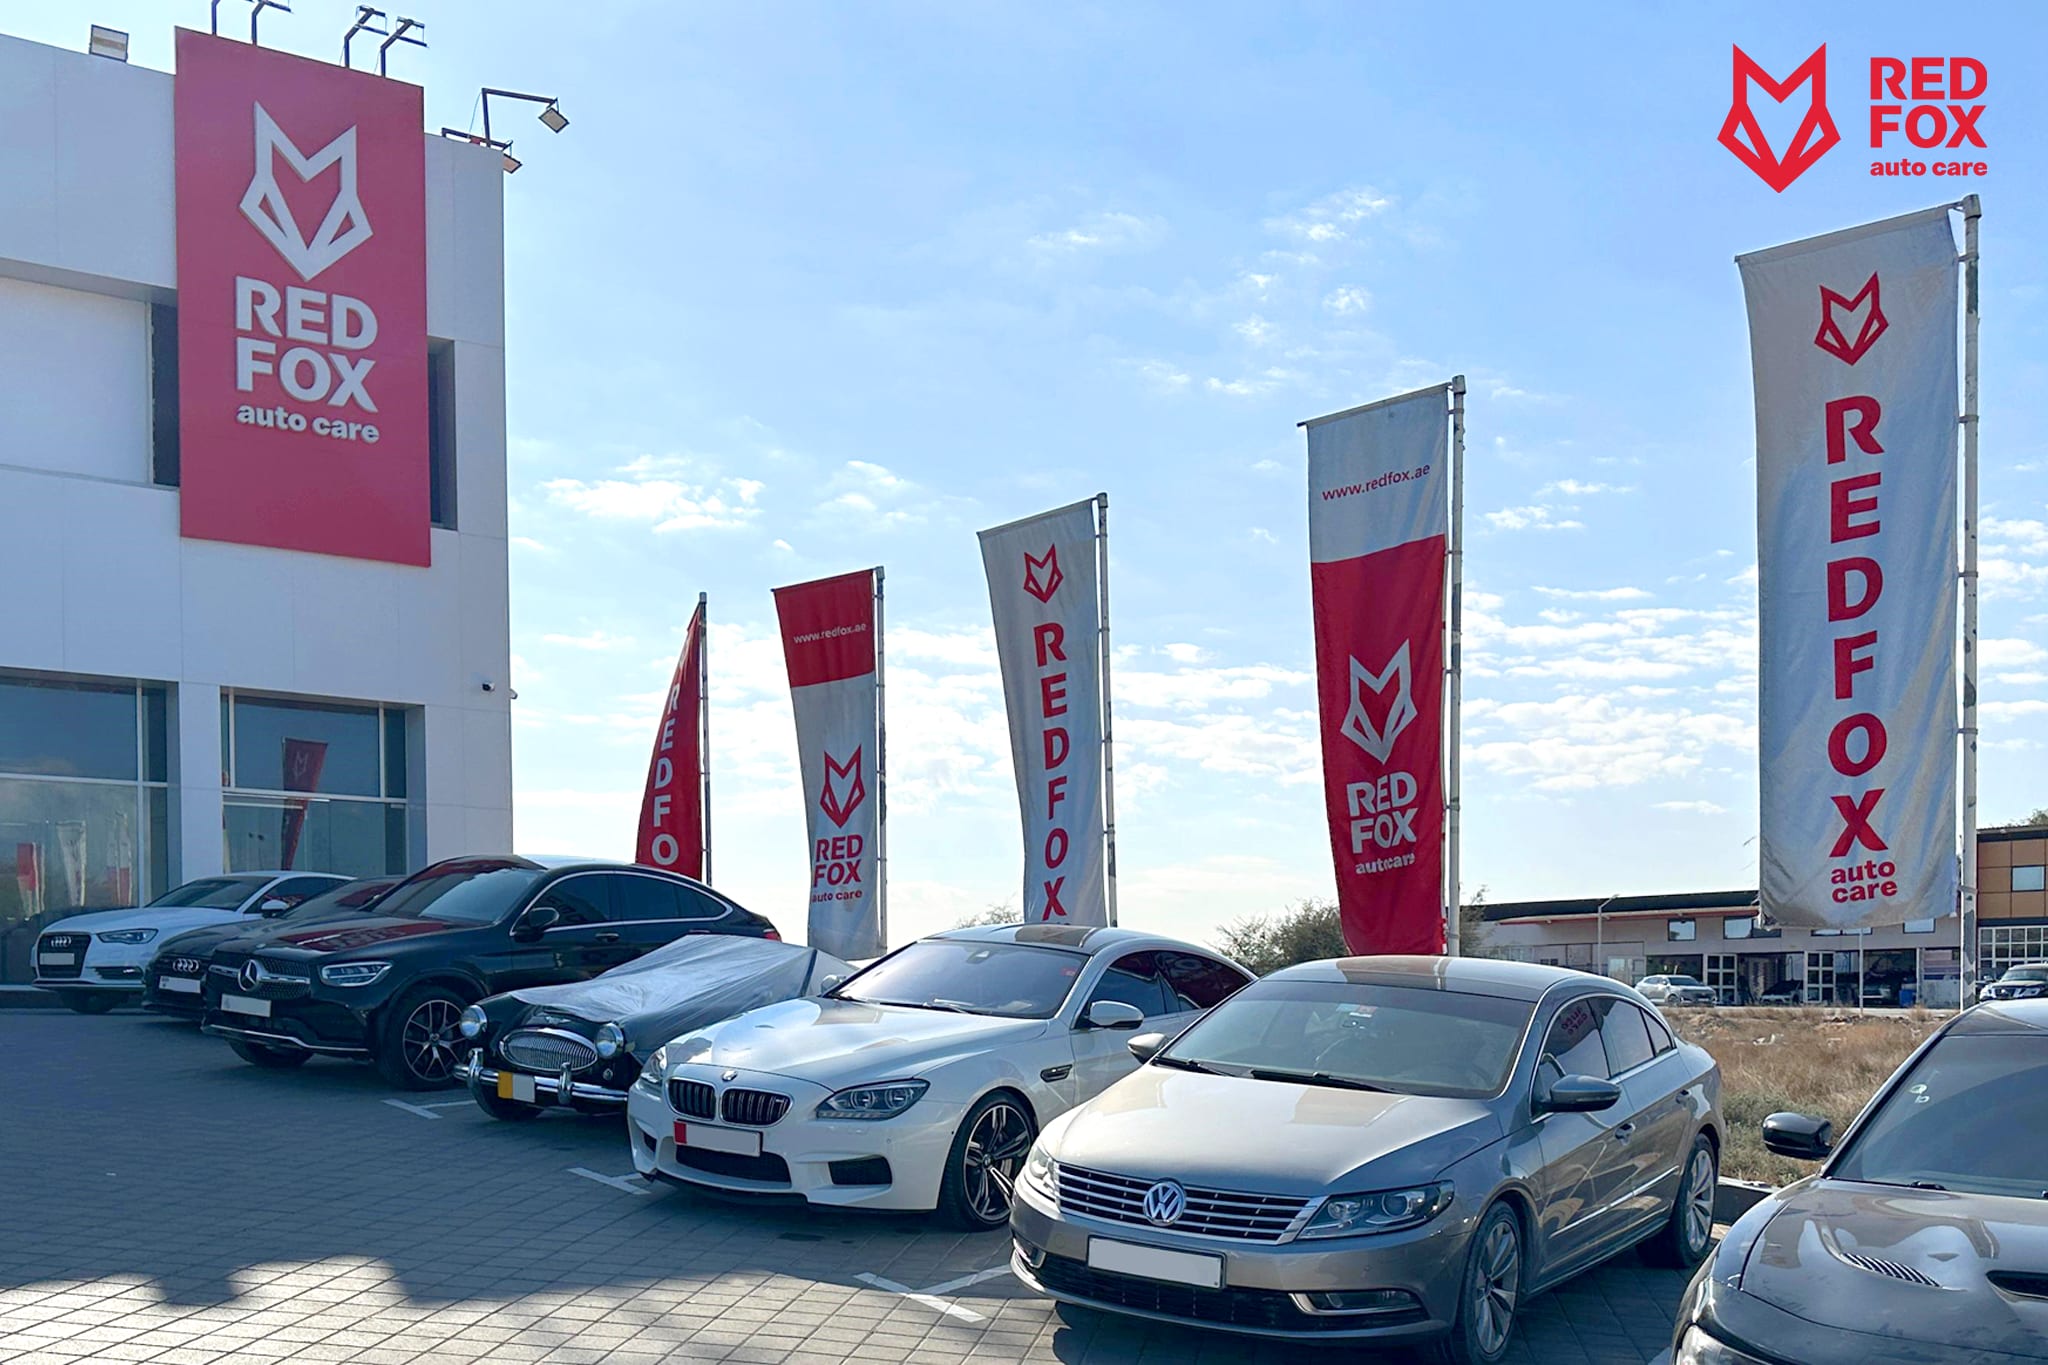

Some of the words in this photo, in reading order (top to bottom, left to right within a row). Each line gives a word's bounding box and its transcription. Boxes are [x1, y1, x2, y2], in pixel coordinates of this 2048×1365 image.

[235, 275, 378, 351] RED
[236, 336, 379, 414] FOX
[236, 404, 308, 432] auto
[312, 416, 380, 443] care
[1322, 464, 1431, 501] www.redfox.ae
[793, 623, 867, 644] www.redfox.ae
[1825, 395, 1886, 858] REDFOX
[1034, 622, 1068, 921] REDFOX
[1346, 771, 1418, 818] RED
[815, 834, 864, 862] RED
[1350, 807, 1419, 854] FOX
[813, 859, 862, 887] FOX
[1831, 860, 1896, 885] auto
[1832, 880, 1898, 903] care
[811, 892, 833, 903] auto
[835, 889, 862, 900] care
